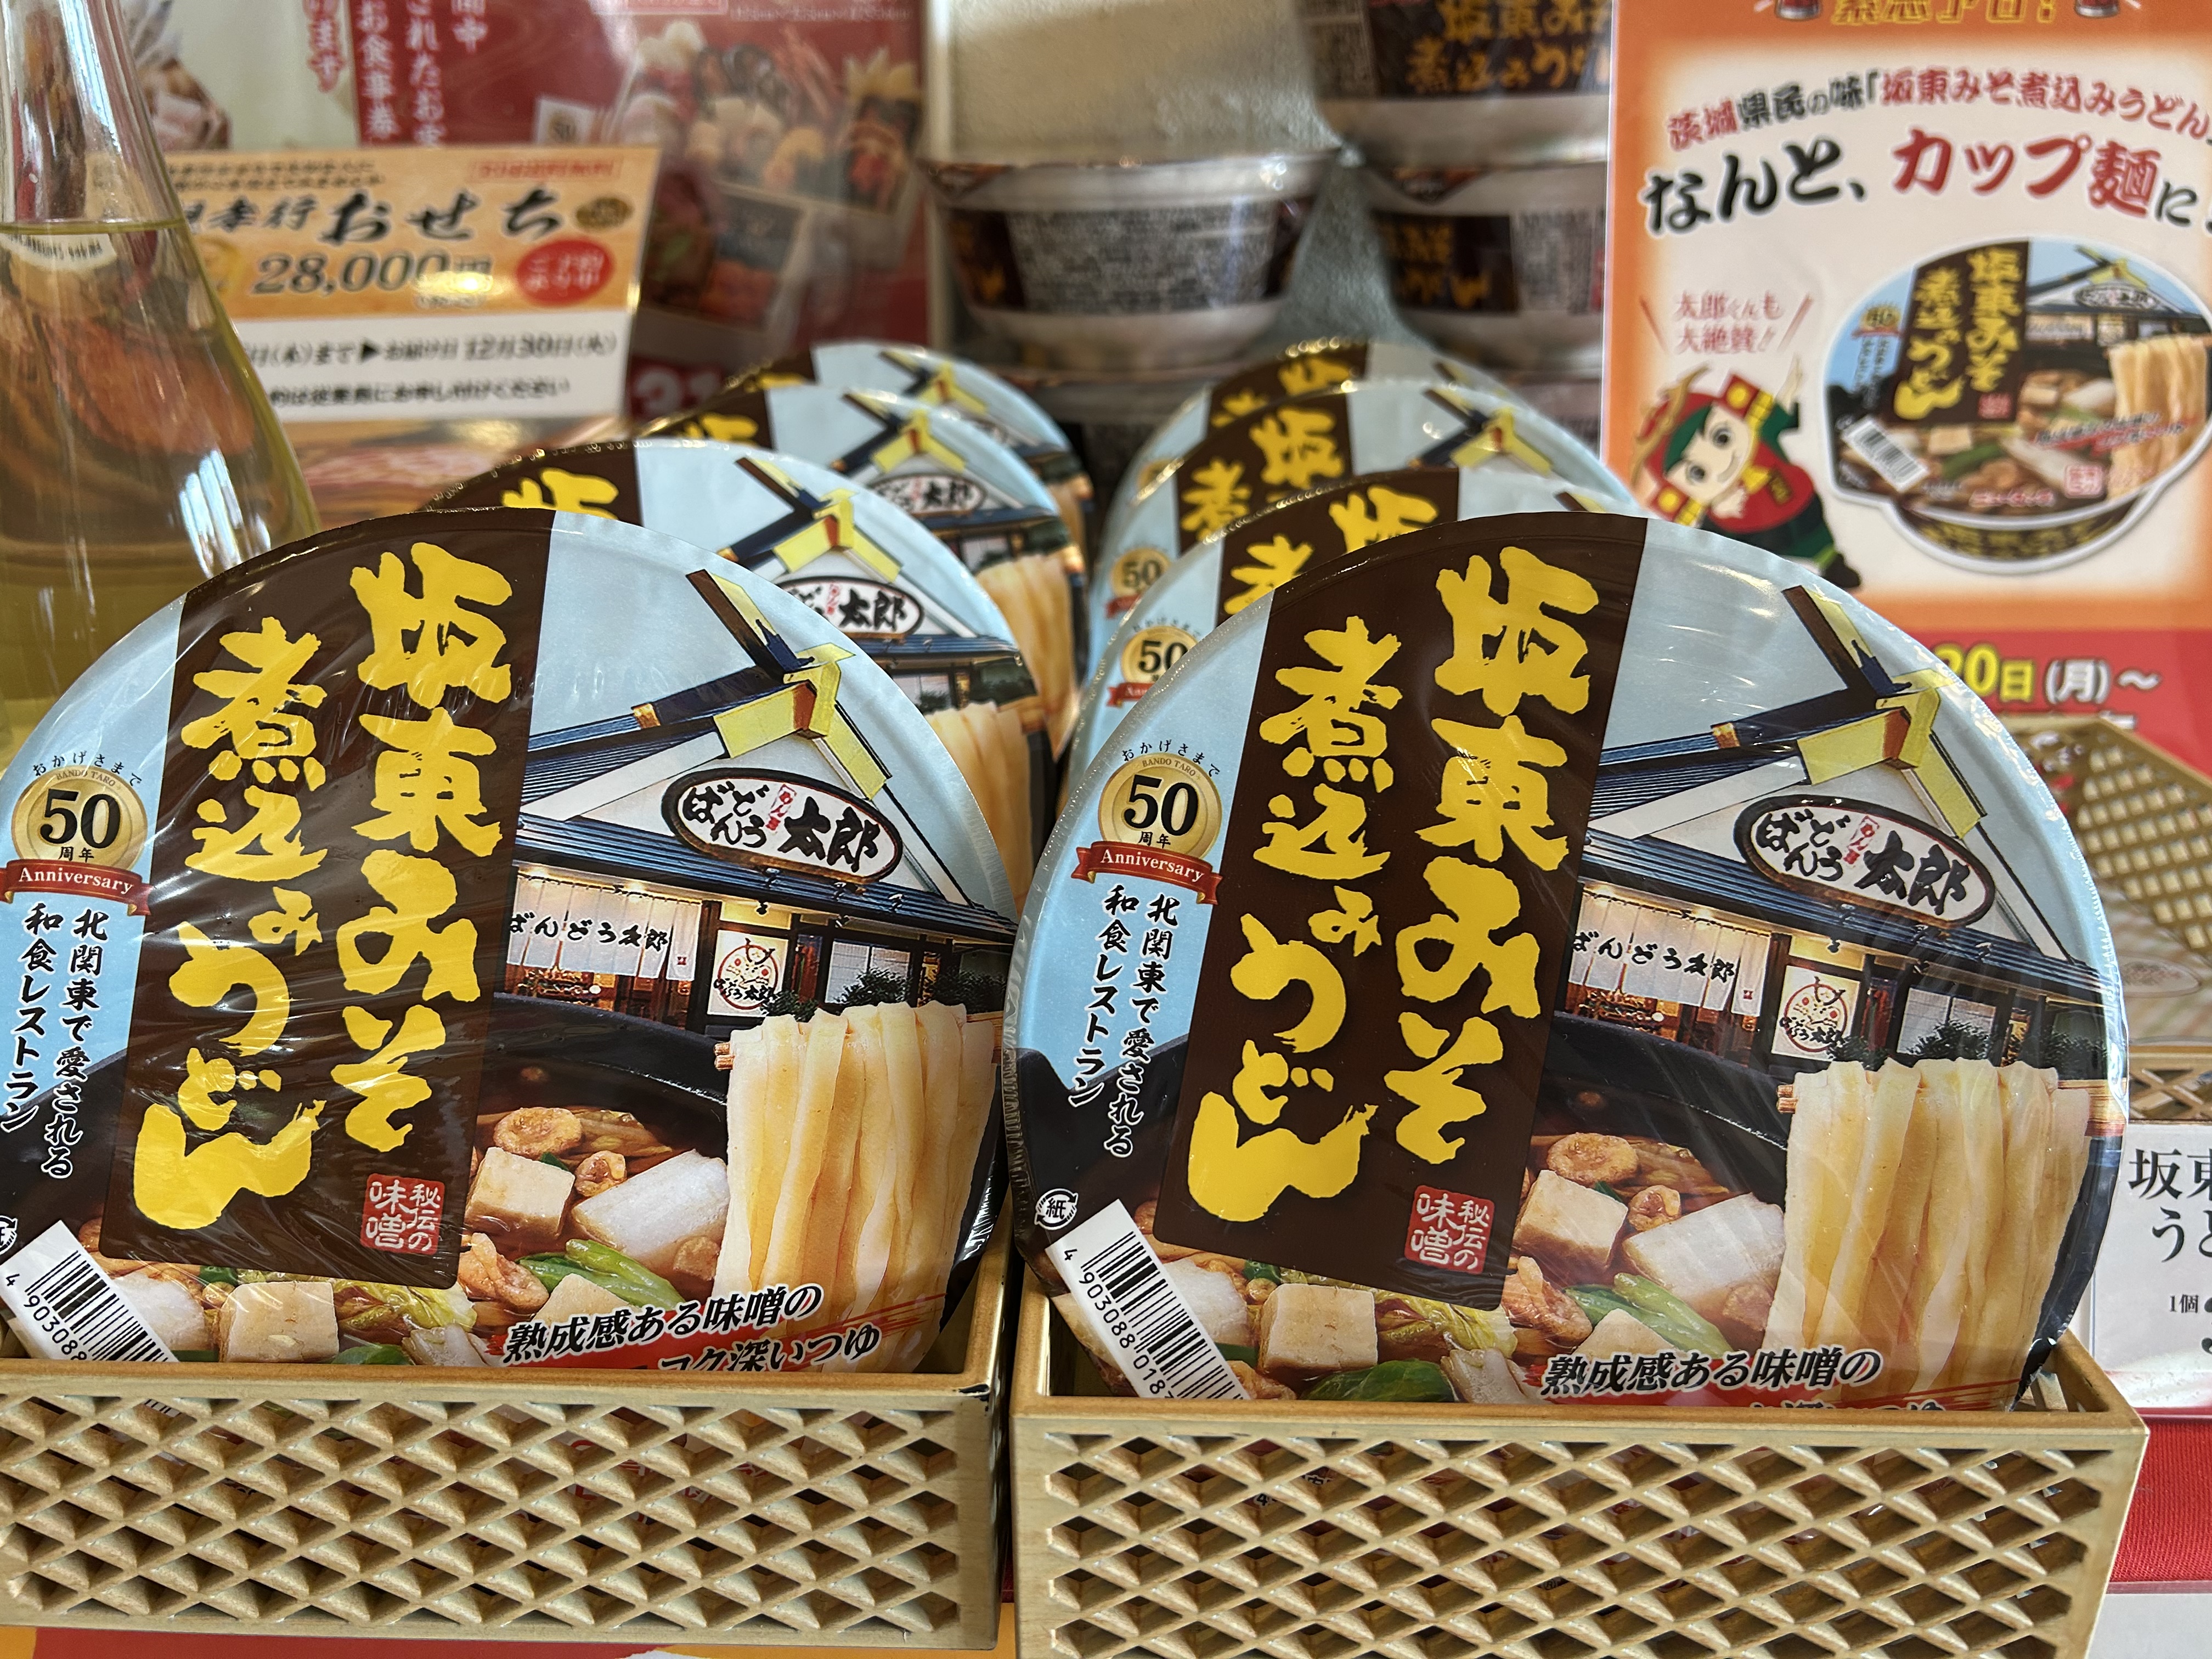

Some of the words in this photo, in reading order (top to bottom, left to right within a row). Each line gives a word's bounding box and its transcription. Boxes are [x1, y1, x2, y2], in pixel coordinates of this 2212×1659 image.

[1668, 68, 2212, 151] 茨城県民の味「坂東みそ煮込みうどん
[1645, 129, 2212, 233] なんと、カップ麺に
[32, 749, 143, 787] おかげさまで
[1122, 739, 1221, 777] おかげさまで
[40, 788, 121, 849] 50
[1123, 774, 1199, 837] 50
[58, 846, 95, 864] 周年
[1100, 848, 1205, 883] Anniversary
[1138, 830, 1172, 849] 周年
[19, 867, 134, 895] Anniversary
[0, 902, 65, 1132] 和食レストラン
[1068, 884, 1141, 1108] 和食レストラン
[1103, 893, 1182, 1158] 北関東で愛される
[41, 907, 109, 1180] 北関東で愛される
[1046, 1197, 1066, 1220] 紙
[503, 1285, 822, 1364] 熟成感ある味噌の
[1063, 1248, 1078, 1262] 4
[1079, 1271, 1136, 1350] 903088
[2169, 1294, 2199, 1314] 1個
[1541, 1347, 1881, 1396] 熟成感ある味噌の
